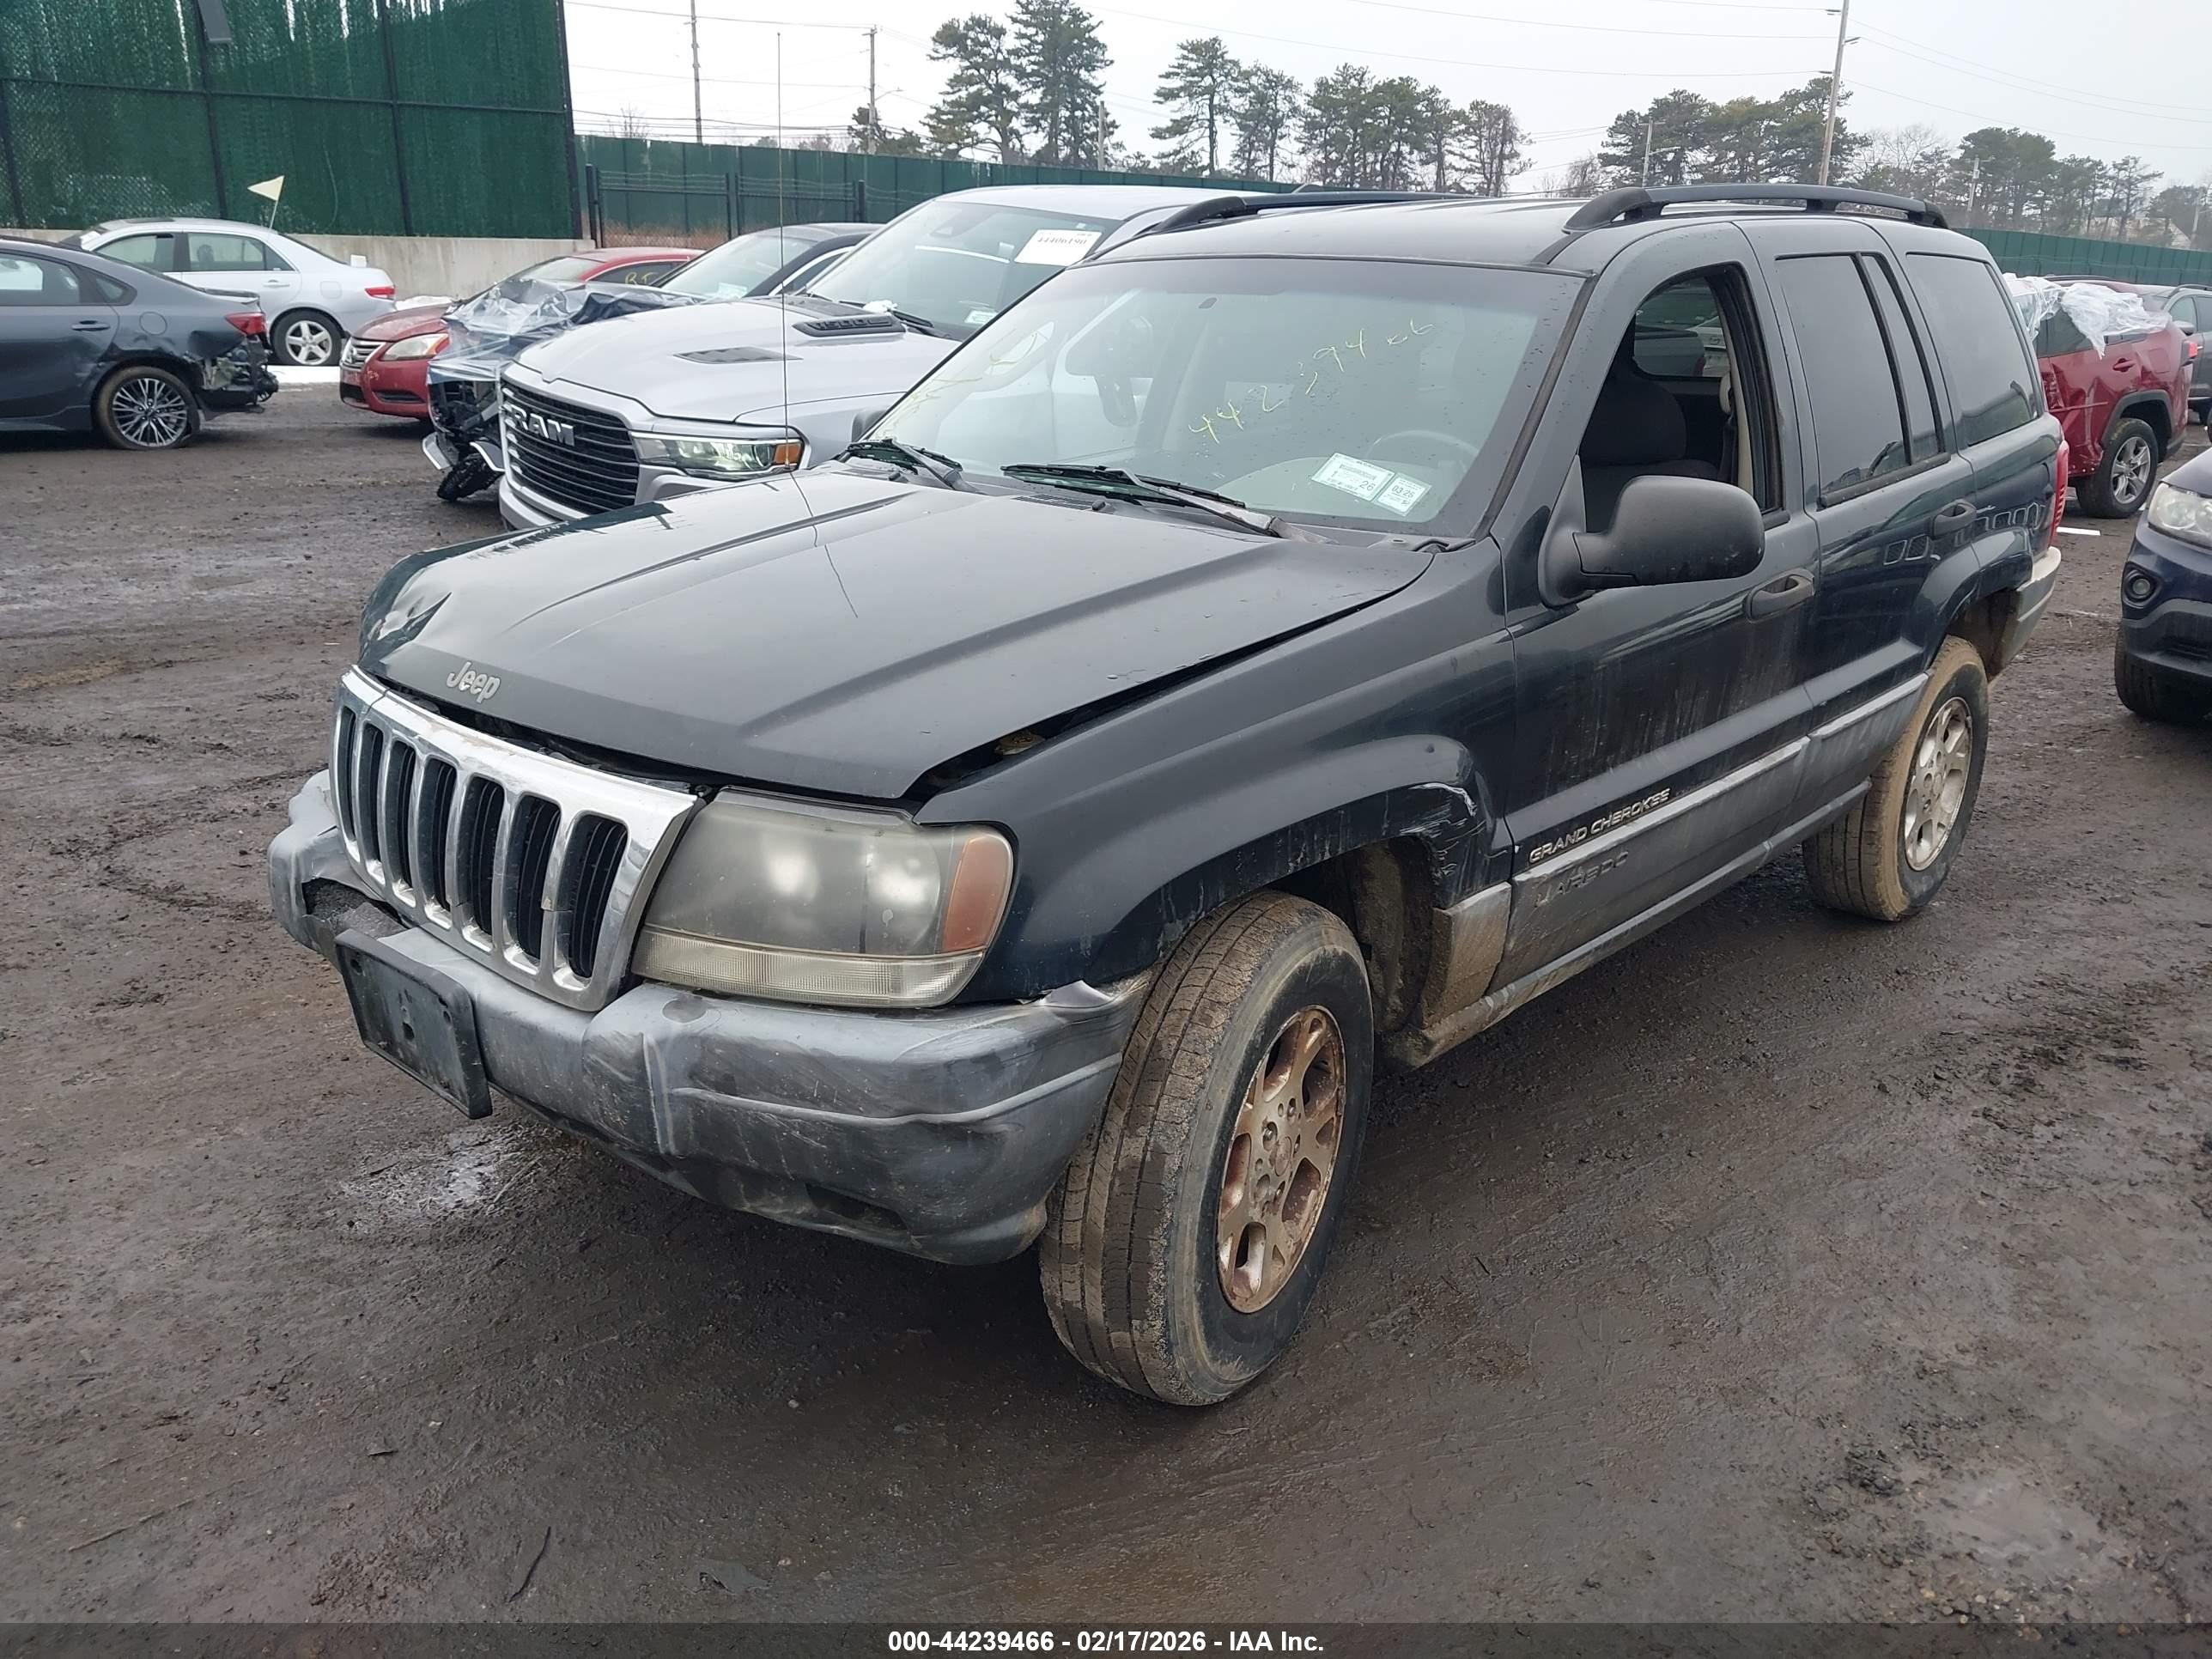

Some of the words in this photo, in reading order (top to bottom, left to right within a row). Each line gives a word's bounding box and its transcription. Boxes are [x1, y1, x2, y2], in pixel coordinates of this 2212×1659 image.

[508, 404, 575, 447] RAM
[446, 660, 501, 704] Jeep
[1528, 826, 1589, 864] GRAND
[1589, 787, 1672, 835] CHEROKEE
